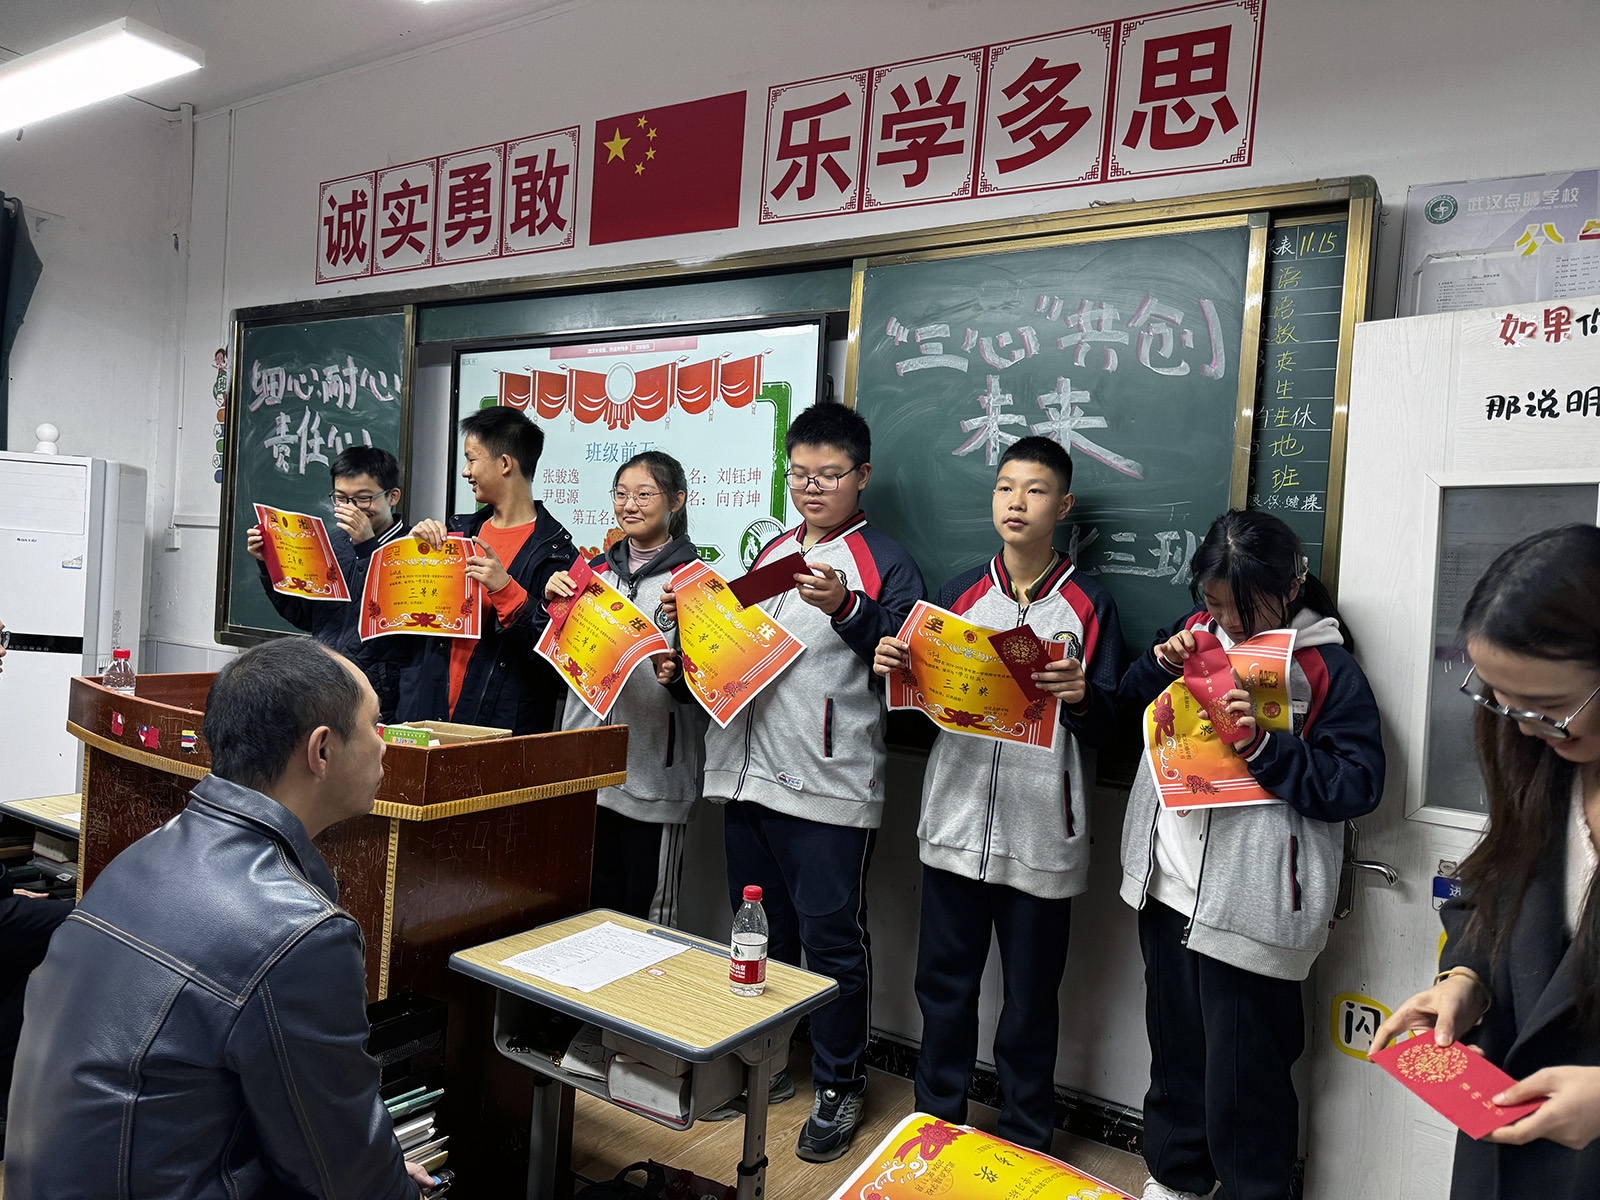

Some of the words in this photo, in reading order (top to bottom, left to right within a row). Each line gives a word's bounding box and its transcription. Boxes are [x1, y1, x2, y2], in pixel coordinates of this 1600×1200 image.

[770, 24, 1239, 201] 乐学多思
[323, 148, 570, 267] 诚实勇敢
[1300, 232, 1337, 256] 11.15
[1272, 323, 1300, 344] 数
[1275, 351, 1298, 373] 英
[1275, 379, 1295, 400] 生
[1486, 388, 1600, 421] 那说明
[952, 374, 1144, 480] 未来
[1268, 433, 1305, 457] 地
[543, 468, 580, 484] 张骏逸
[1272, 464, 1300, 493] 班
[543, 488, 579, 504] 尹思源
[943, 678, 990, 697] 三等奖
